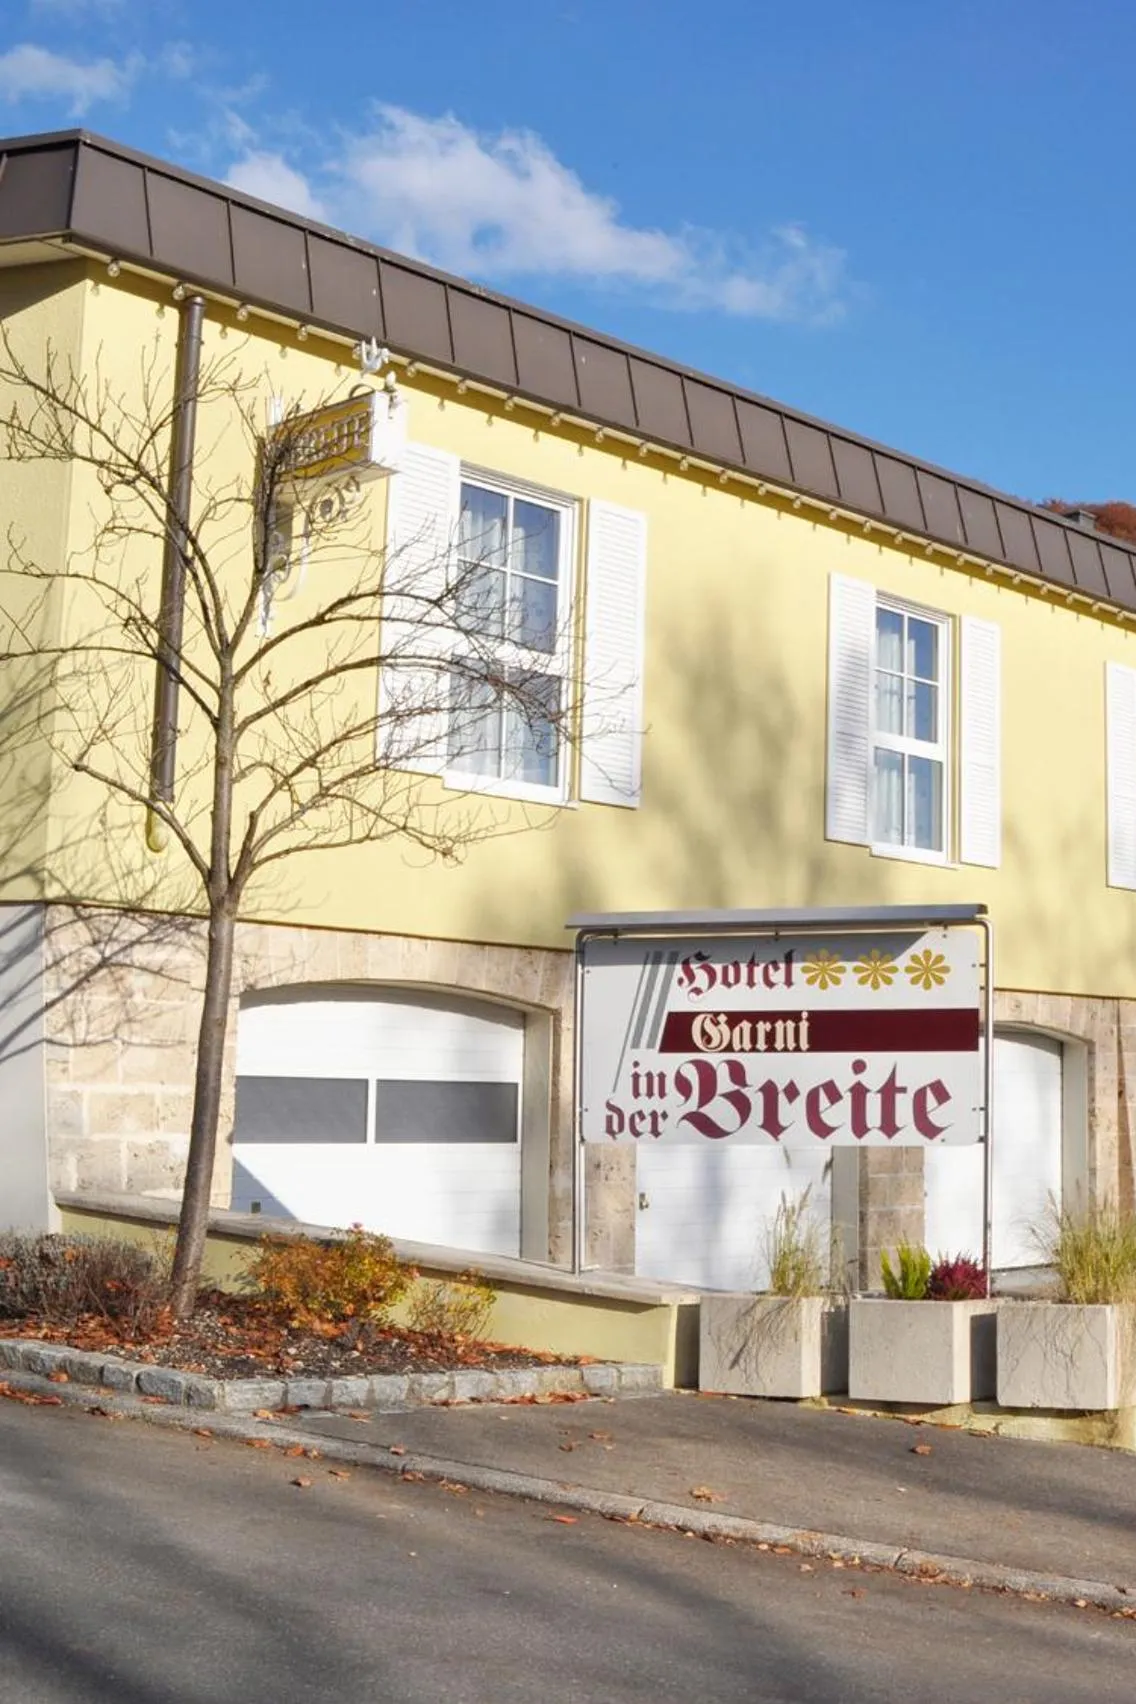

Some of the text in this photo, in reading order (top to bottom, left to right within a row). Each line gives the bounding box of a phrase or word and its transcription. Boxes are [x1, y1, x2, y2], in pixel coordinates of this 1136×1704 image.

[677, 949, 796, 998] Hotel
[691, 1010, 811, 1053] Garni
[631, 1060, 668, 1099] in
[673, 1058, 954, 1141] Breite
[605, 1100, 669, 1140] der
